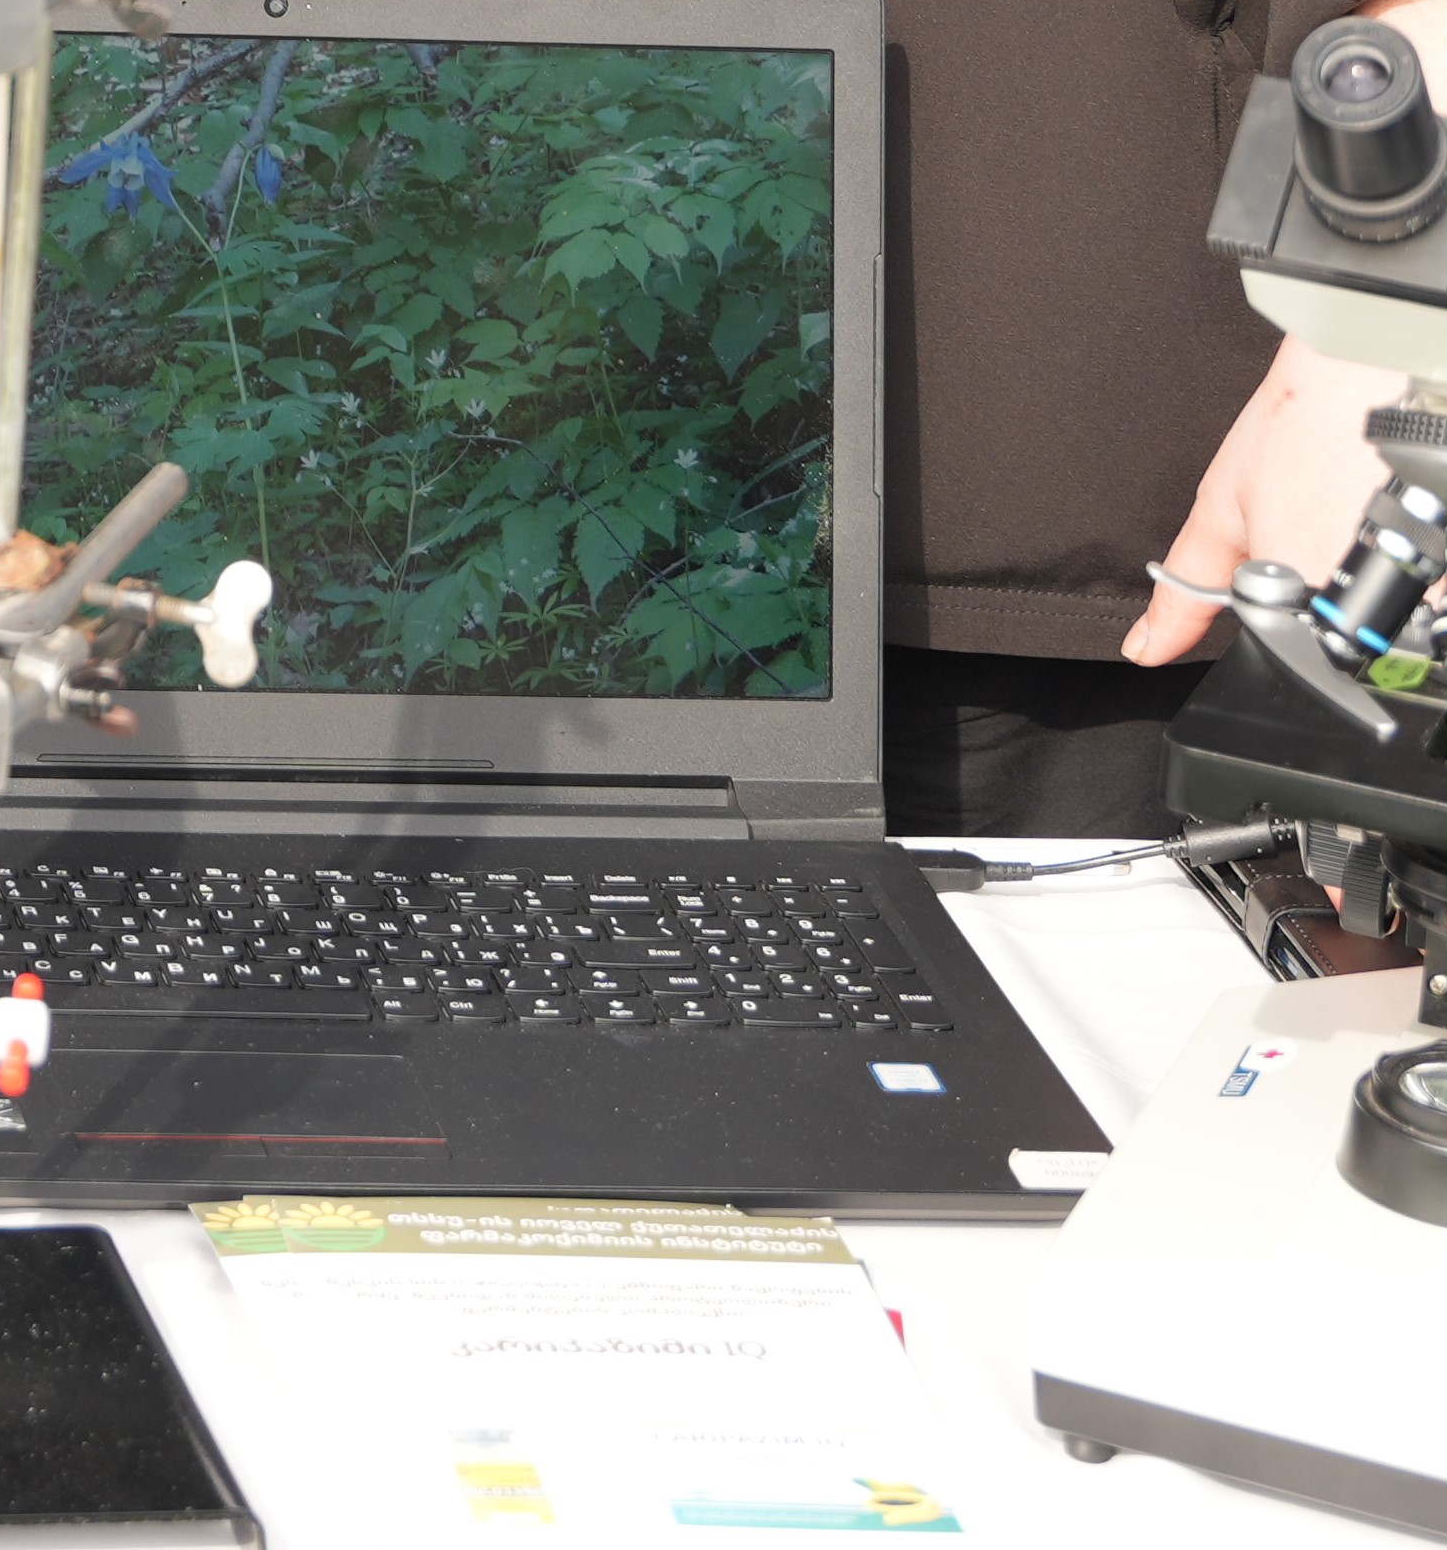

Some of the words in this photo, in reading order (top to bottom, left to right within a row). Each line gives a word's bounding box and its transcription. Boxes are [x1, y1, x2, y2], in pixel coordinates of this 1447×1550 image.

[647, 948, 681, 957] Enter
[668, 976, 699, 985] Shift
[899, 994, 933, 1002] Enter
[519, 1217, 624, 1234] იოველ
[630, 1220, 839, 1240] ქუთათელაძის
[419, 1228, 654, 1249] ფარმაკოქიმიის
[661, 1236, 825, 1255] ინსტიტუტი
[722, 1339, 768, 1361] IQ
